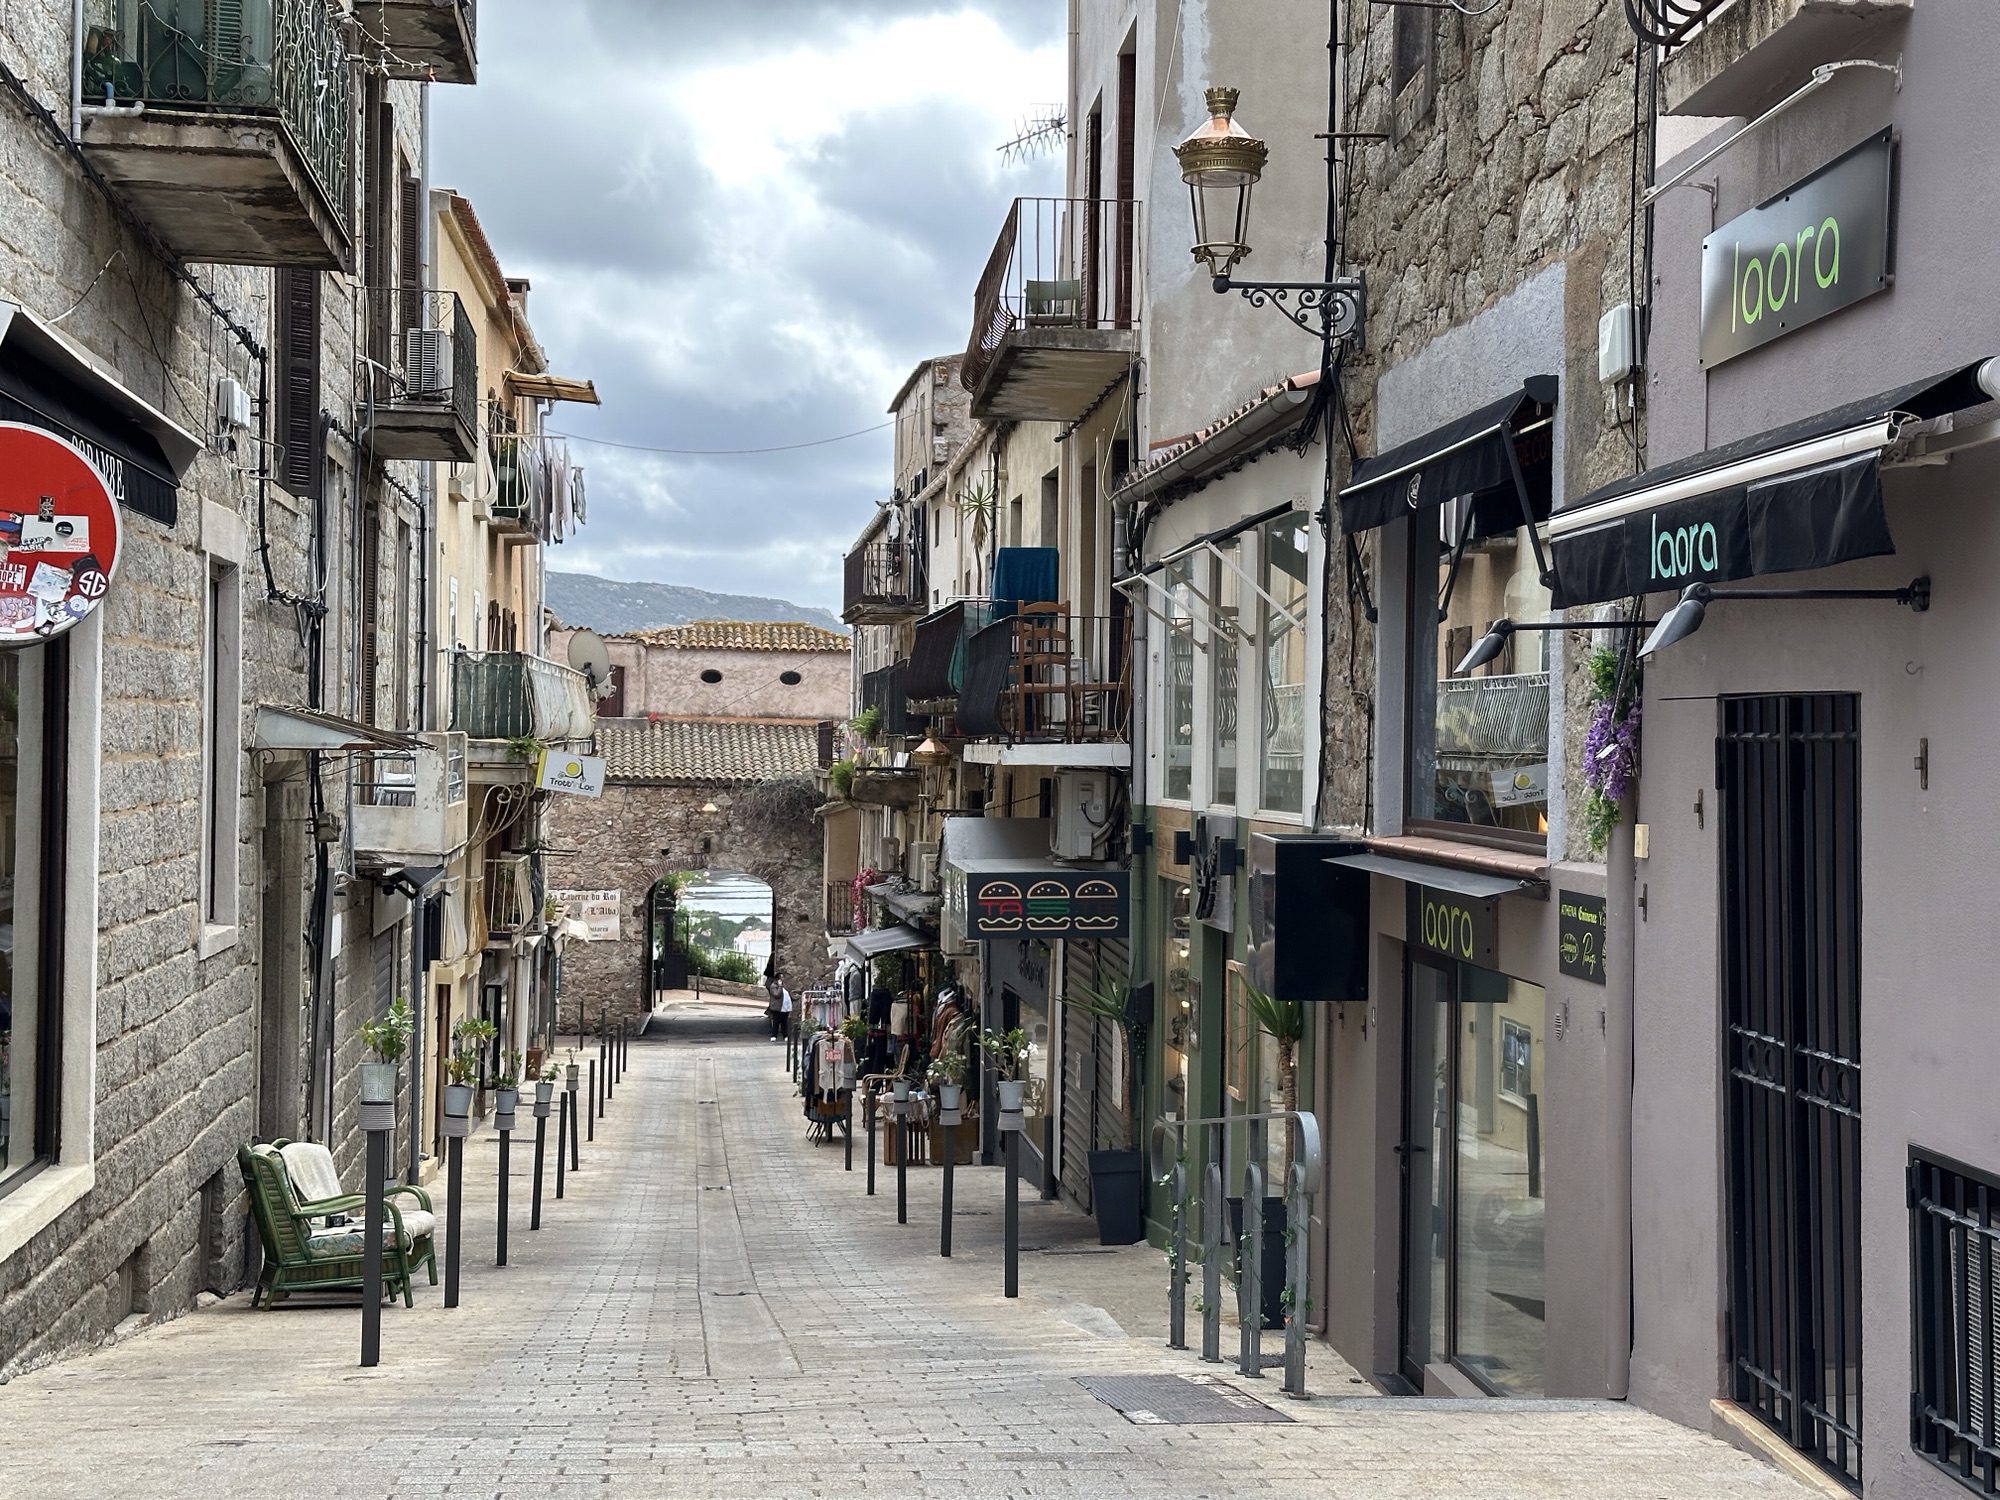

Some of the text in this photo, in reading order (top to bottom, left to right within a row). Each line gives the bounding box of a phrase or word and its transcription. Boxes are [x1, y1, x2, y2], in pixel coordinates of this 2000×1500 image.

[1731, 215, 1840, 334] laora
[1650, 513, 1719, 579] laora
[578, 782, 594, 792] Loc
[560, 892, 589, 901] Taverne
[591, 892, 600, 901] du
[602, 892, 617, 901] Roi
[1420, 885, 1474, 961] laora
